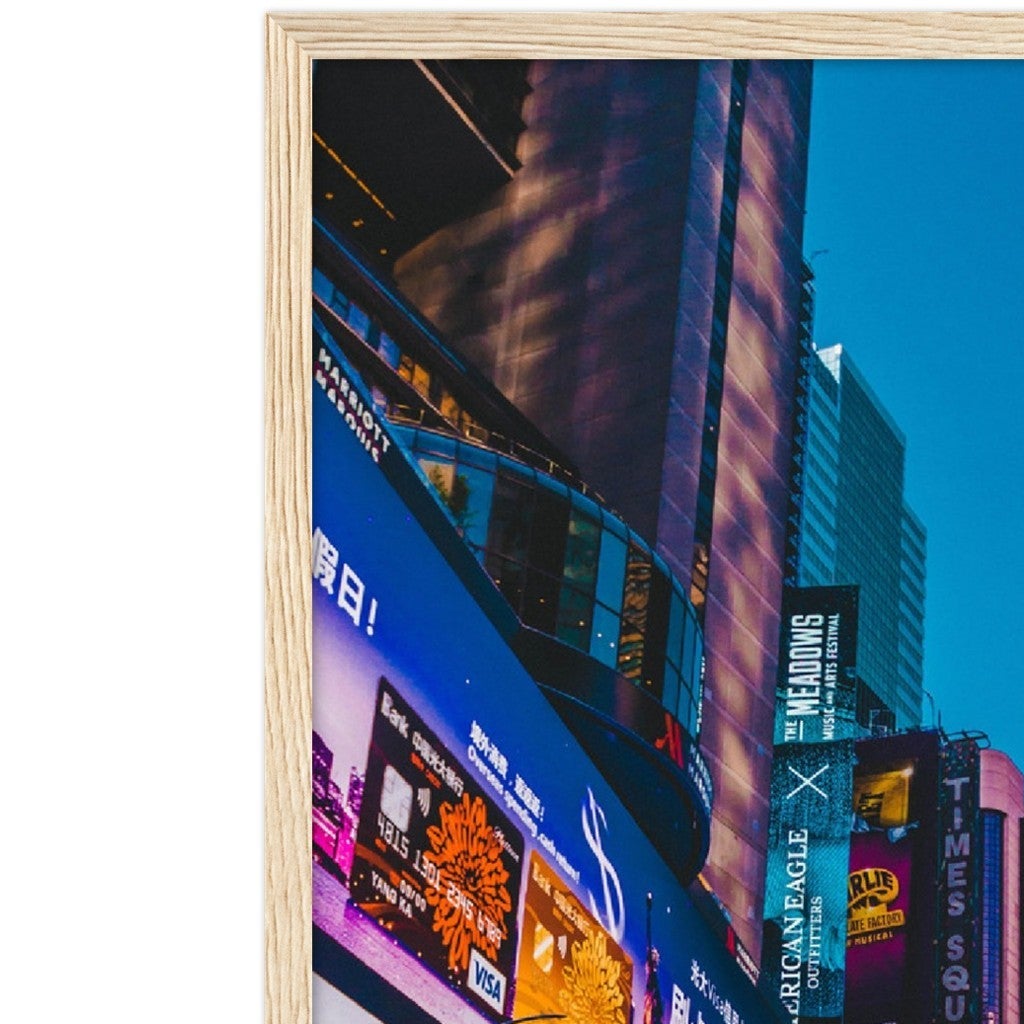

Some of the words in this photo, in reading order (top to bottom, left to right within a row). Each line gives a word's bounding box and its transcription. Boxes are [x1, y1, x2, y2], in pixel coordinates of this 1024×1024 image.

[826, 613, 840, 659] FESTIVAL
[786, 614, 825, 716] MEADOWS
[824, 662, 838, 689] ARTS
[784, 720, 798, 742] THE
[822, 707, 836, 740] MUSIC
[944, 776, 970, 917] TIMES
[785, 828, 808, 911] EAGLE
[849, 870, 894, 900] RLIE
[807, 896, 823, 990] OUTFITTERS
[854, 930, 894, 945] MUSICAL
[474, 960, 501, 1003] VISA
